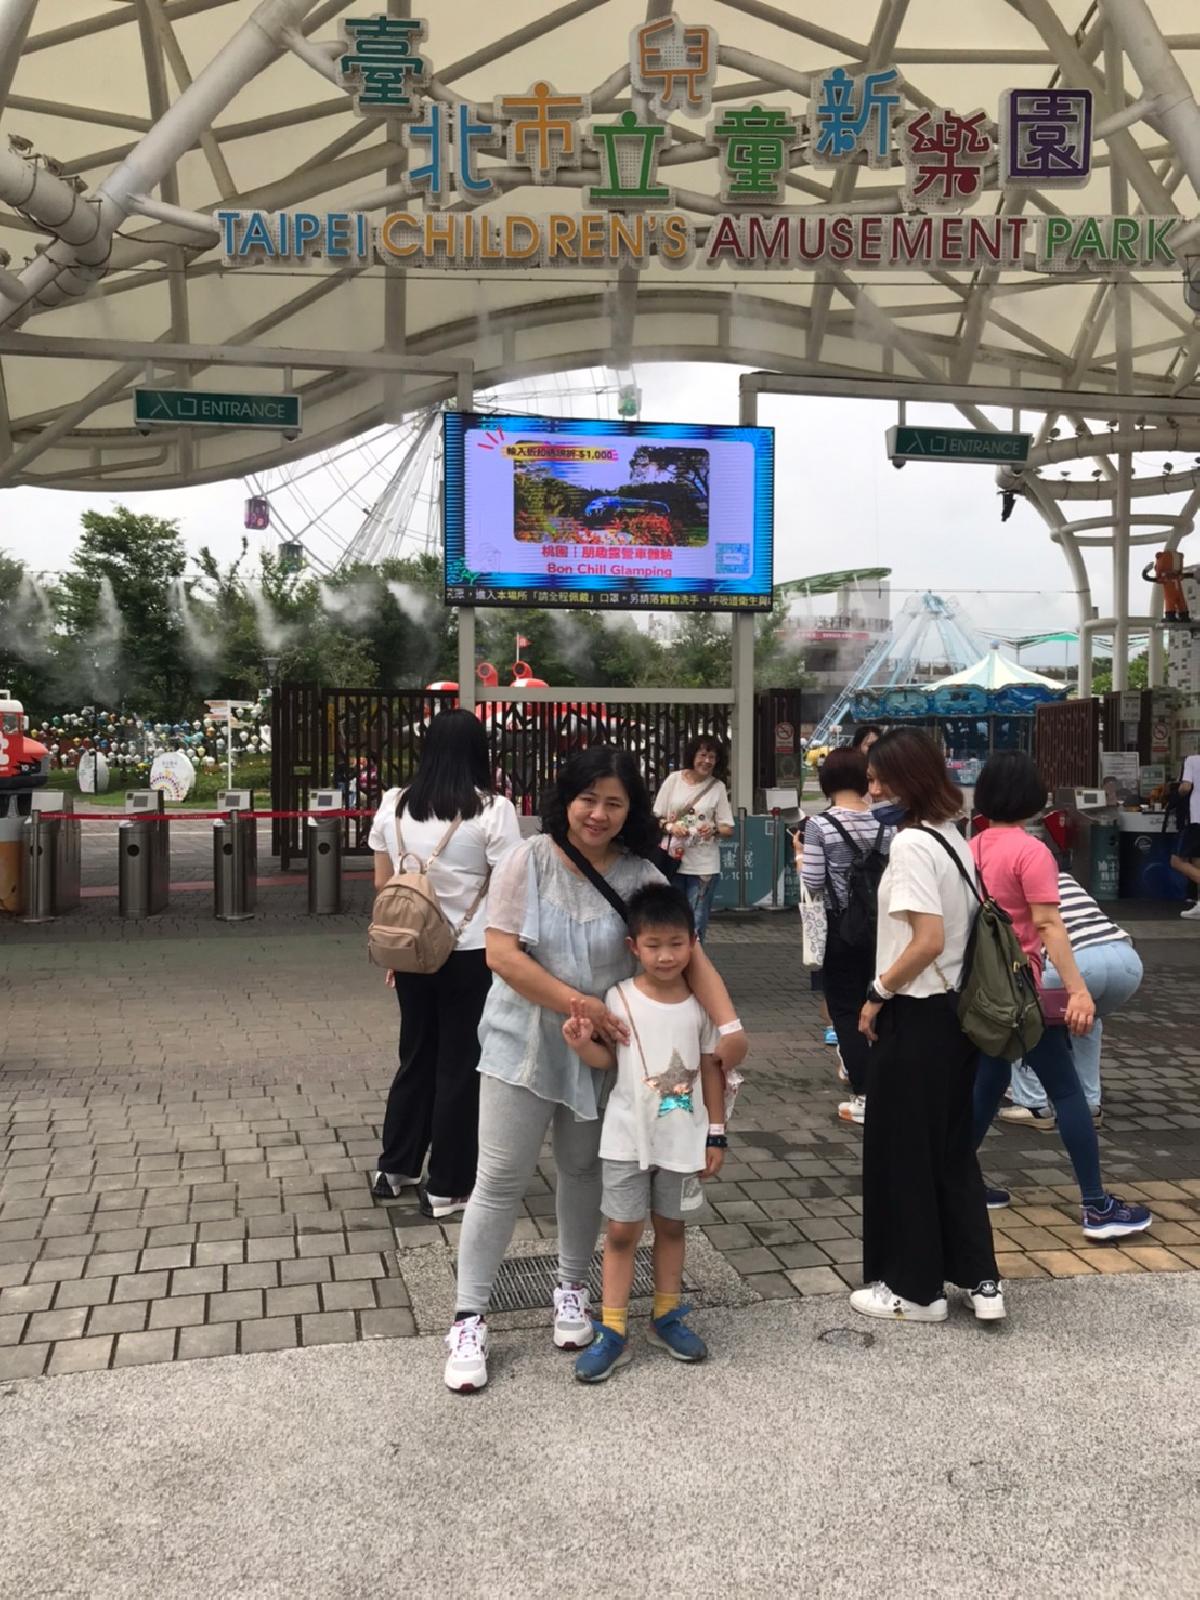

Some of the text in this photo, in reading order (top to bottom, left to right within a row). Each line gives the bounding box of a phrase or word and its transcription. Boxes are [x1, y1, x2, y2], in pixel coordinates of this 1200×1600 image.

[217, 212, 1177, 261] TAIPEI CHILDREN'S AMUSEMENT PARK
[150, 391, 286, 418] 入口 ENTRANCE
[906, 432, 1020, 455] 入口 ENTRANCE
[547, 562, 673, 579] Bon Chill Glamping
